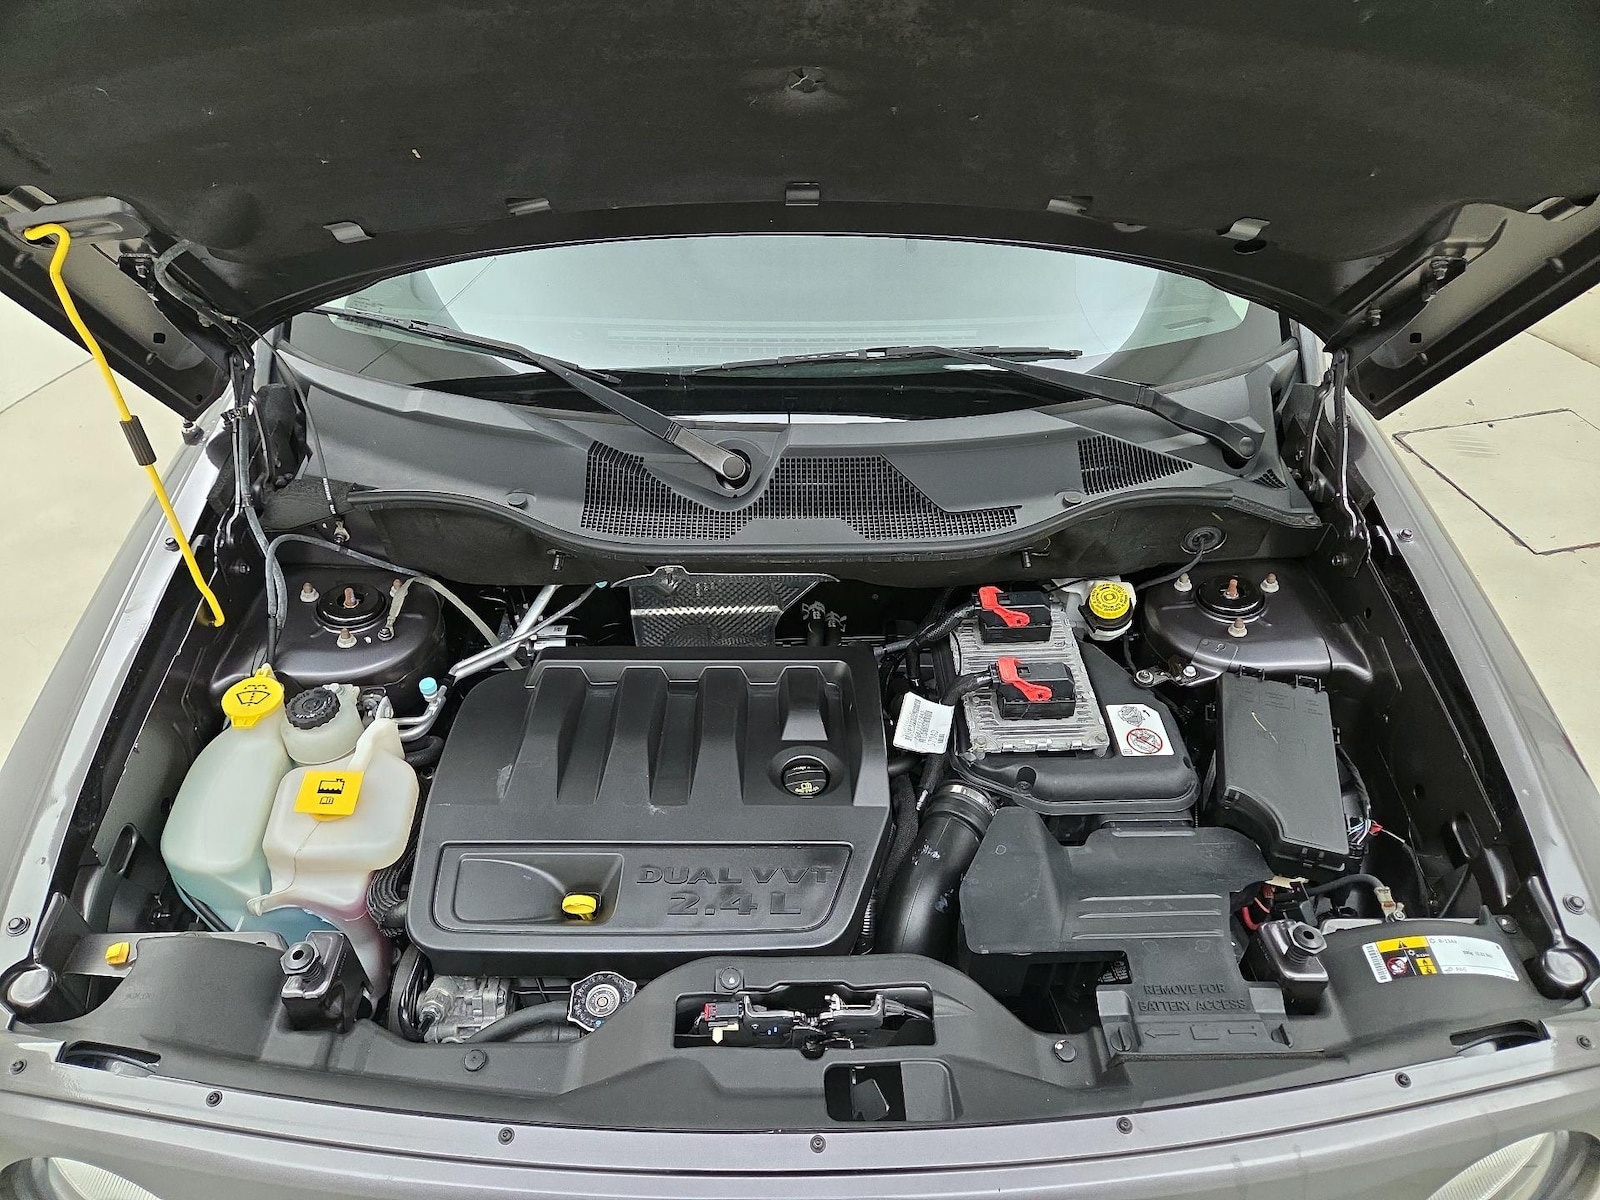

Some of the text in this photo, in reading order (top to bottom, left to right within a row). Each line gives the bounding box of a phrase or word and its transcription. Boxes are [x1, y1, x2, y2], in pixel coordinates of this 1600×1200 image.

[636, 865, 833, 885] DUAL VVT
[1143, 982, 1227, 996] REMOVE FOR
[1138, 999, 1247, 1012] BATTERY ACCESS
